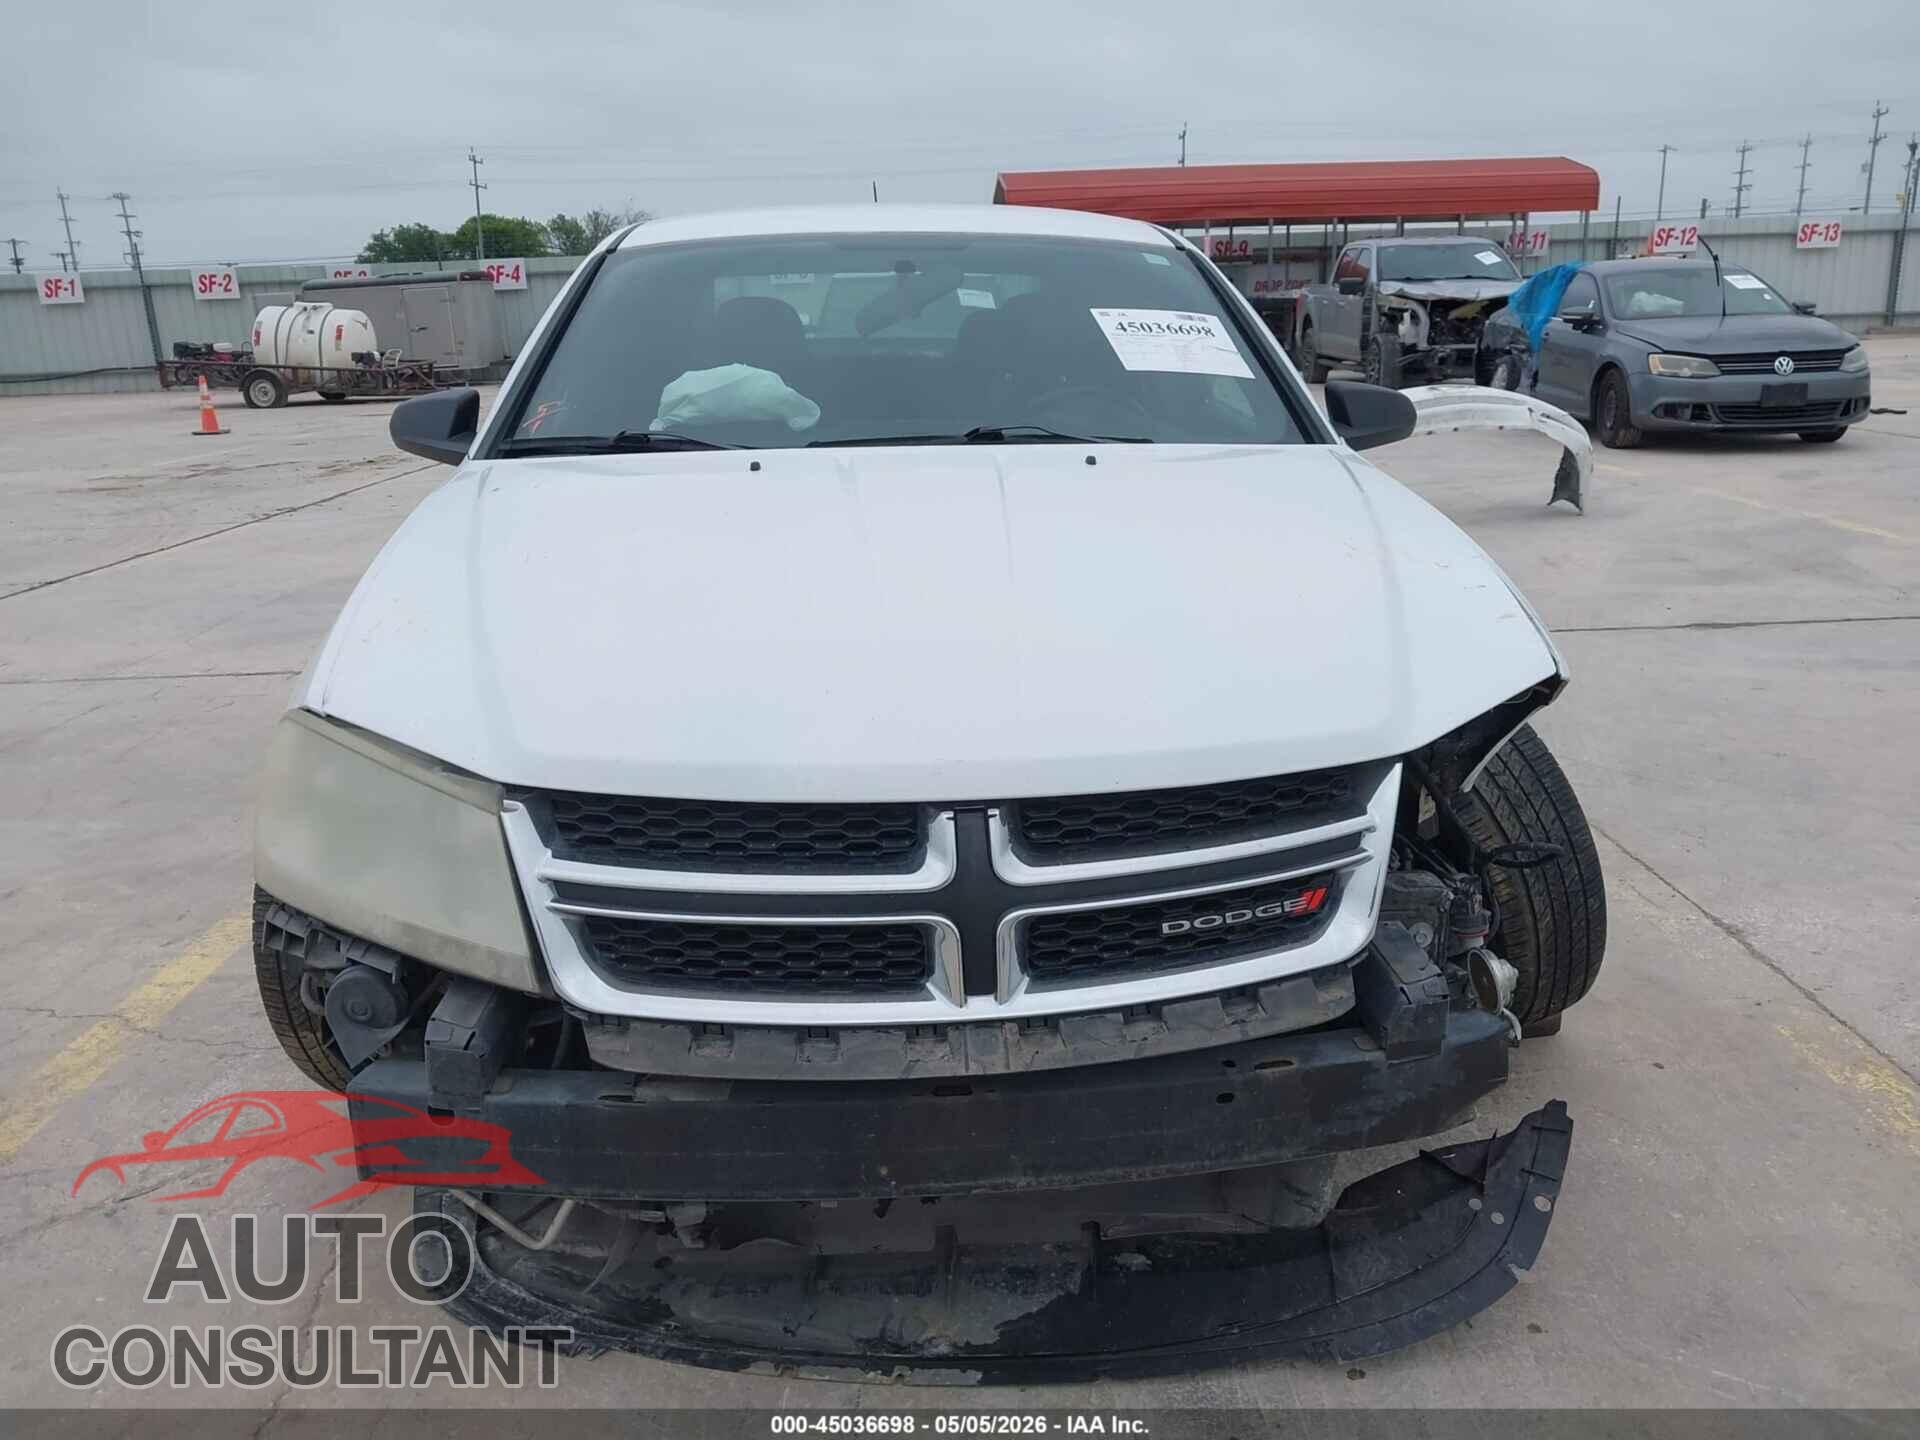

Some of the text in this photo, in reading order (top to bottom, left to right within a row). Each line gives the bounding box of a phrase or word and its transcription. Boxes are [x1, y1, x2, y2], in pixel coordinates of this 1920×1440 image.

[1655, 226, 1697, 247] SF-12
[1799, 222, 1840, 242] SF-13
[44, 278, 76, 298] SF-1
[198, 273, 233, 293] SF-2
[1114, 321, 1216, 338] 45036698
[1161, 896, 1308, 934] DODGE
